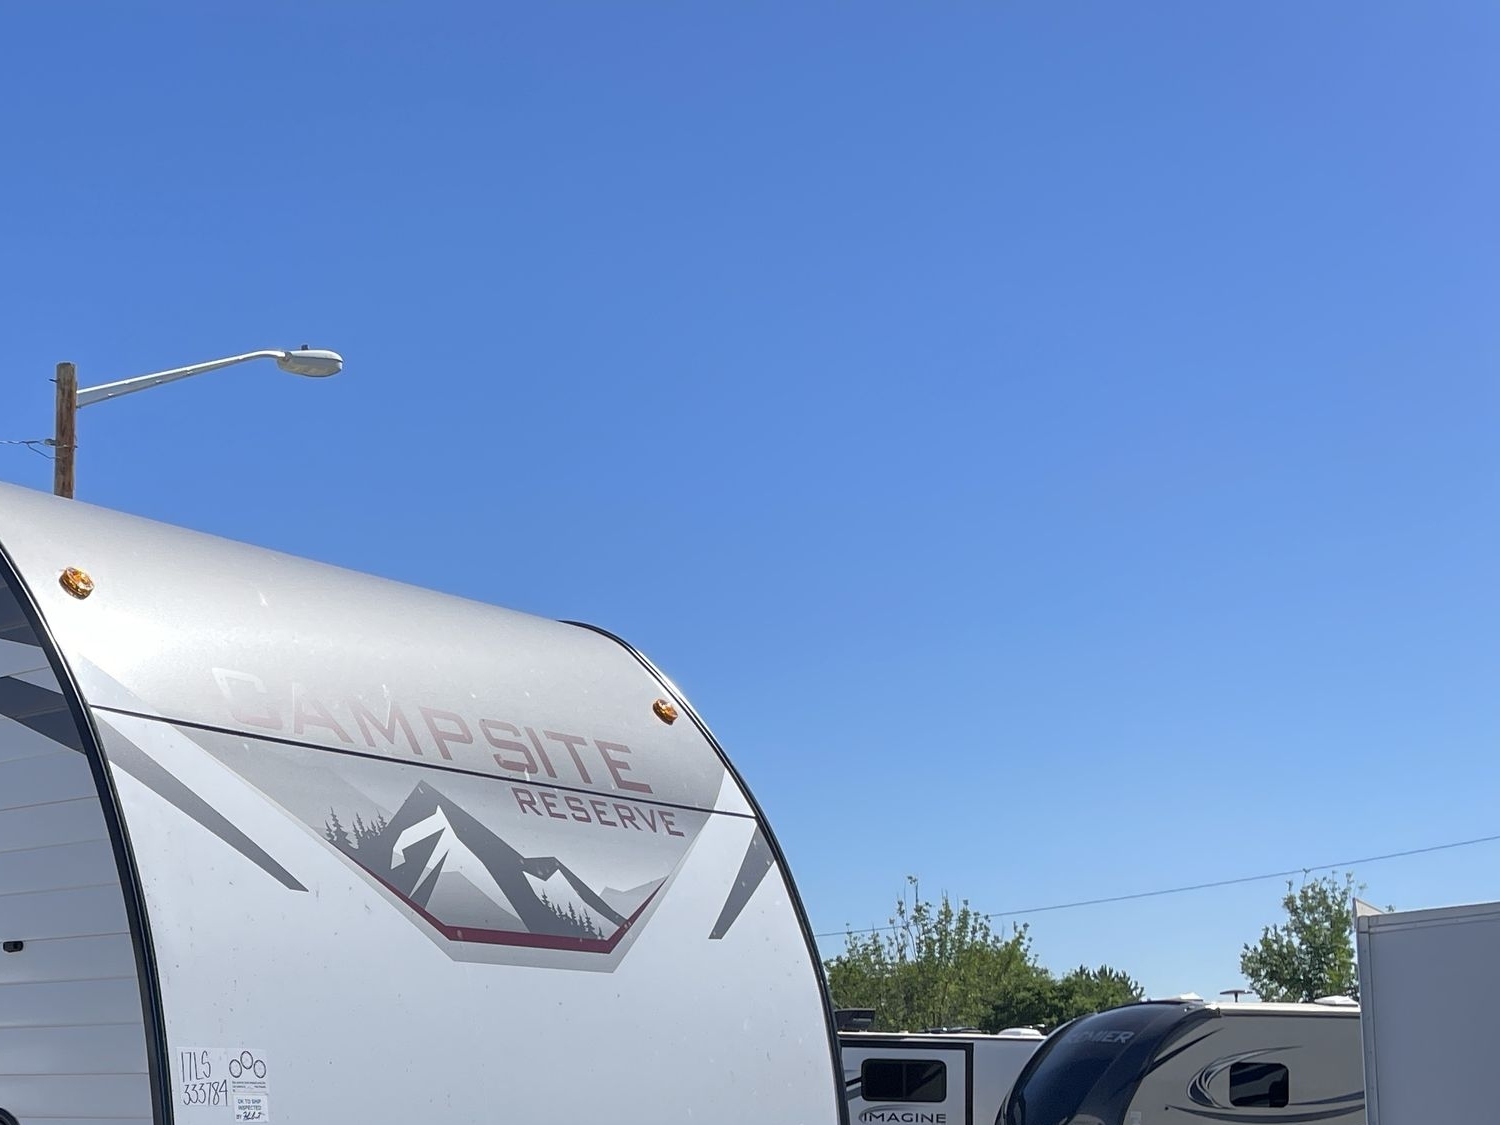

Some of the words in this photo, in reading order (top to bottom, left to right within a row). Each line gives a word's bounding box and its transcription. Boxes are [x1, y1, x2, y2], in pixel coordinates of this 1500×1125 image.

[211, 667, 653, 794] CAMPSITE
[511, 786, 685, 837] RESERVE
[183, 1080, 228, 1106] 333784
[863, 1112, 947, 1124] IMAGINE
